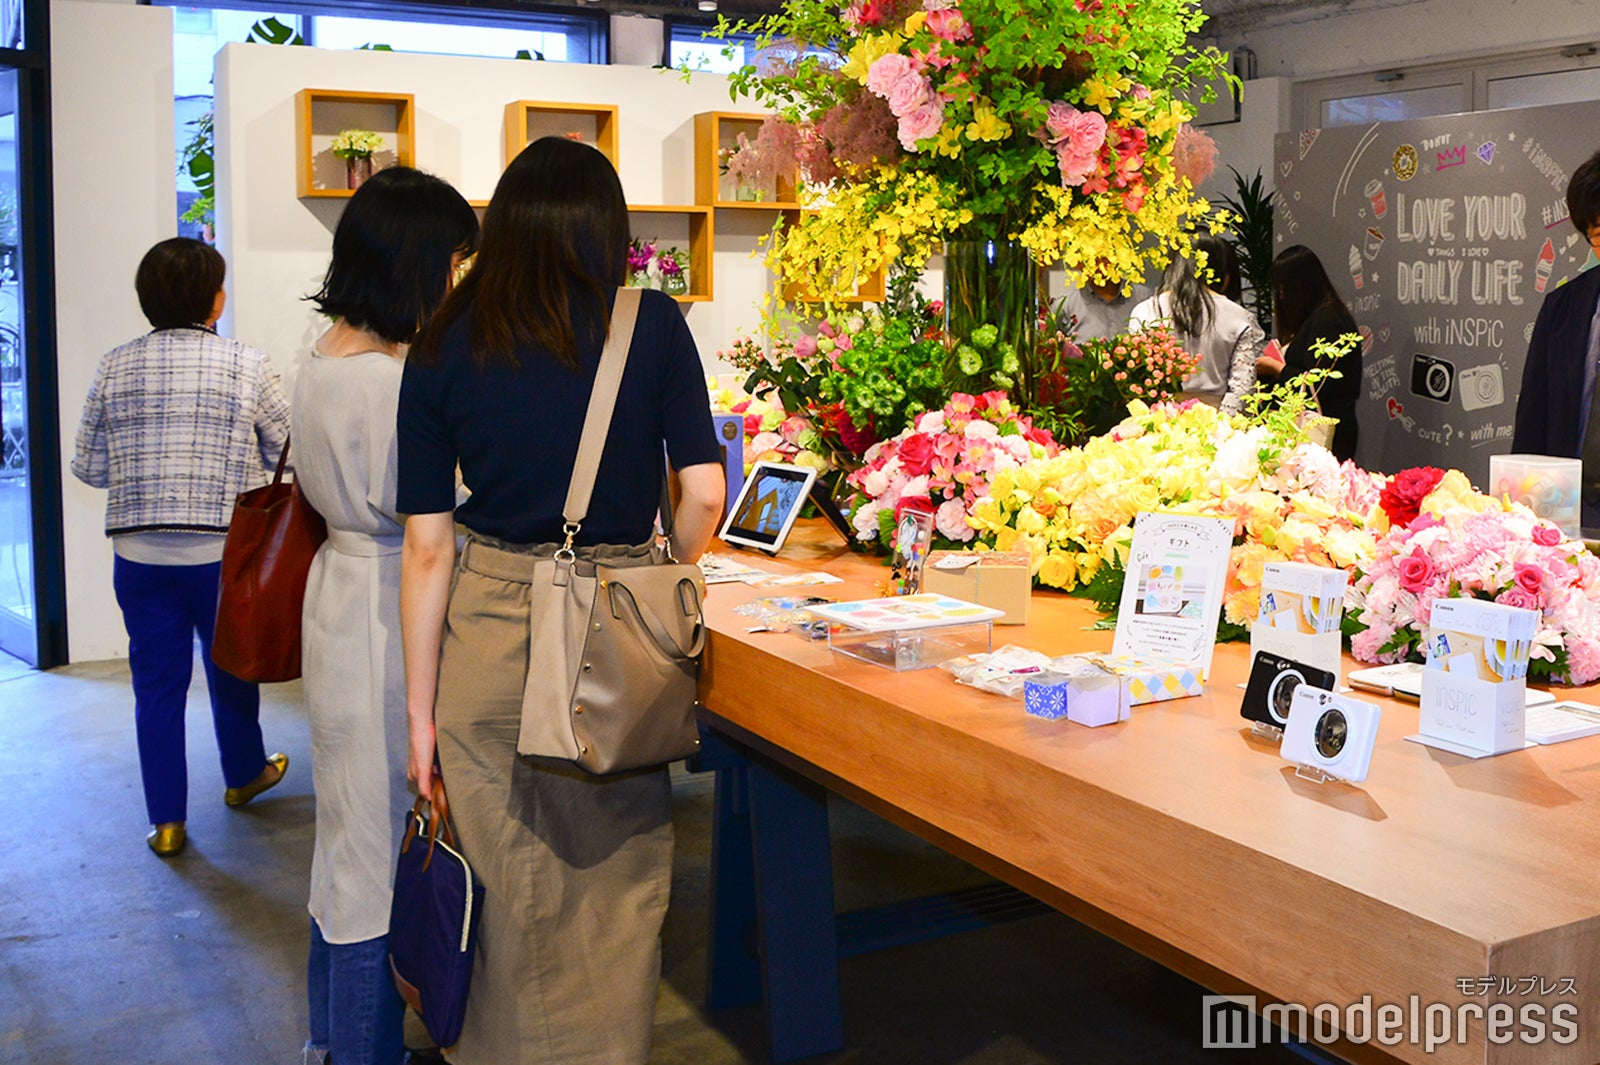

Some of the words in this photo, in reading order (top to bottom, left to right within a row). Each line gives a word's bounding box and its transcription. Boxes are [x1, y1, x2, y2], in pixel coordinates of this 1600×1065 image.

[1397, 192, 1455, 243] LOVE
[1464, 192, 1527, 242] YOUR
[1397, 260, 1465, 306] DAILY
[1471, 260, 1524, 306] LIFE
[1414, 316, 1441, 344] with
[1470, 421, 1495, 441] with
[1496, 424, 1513, 438] me
